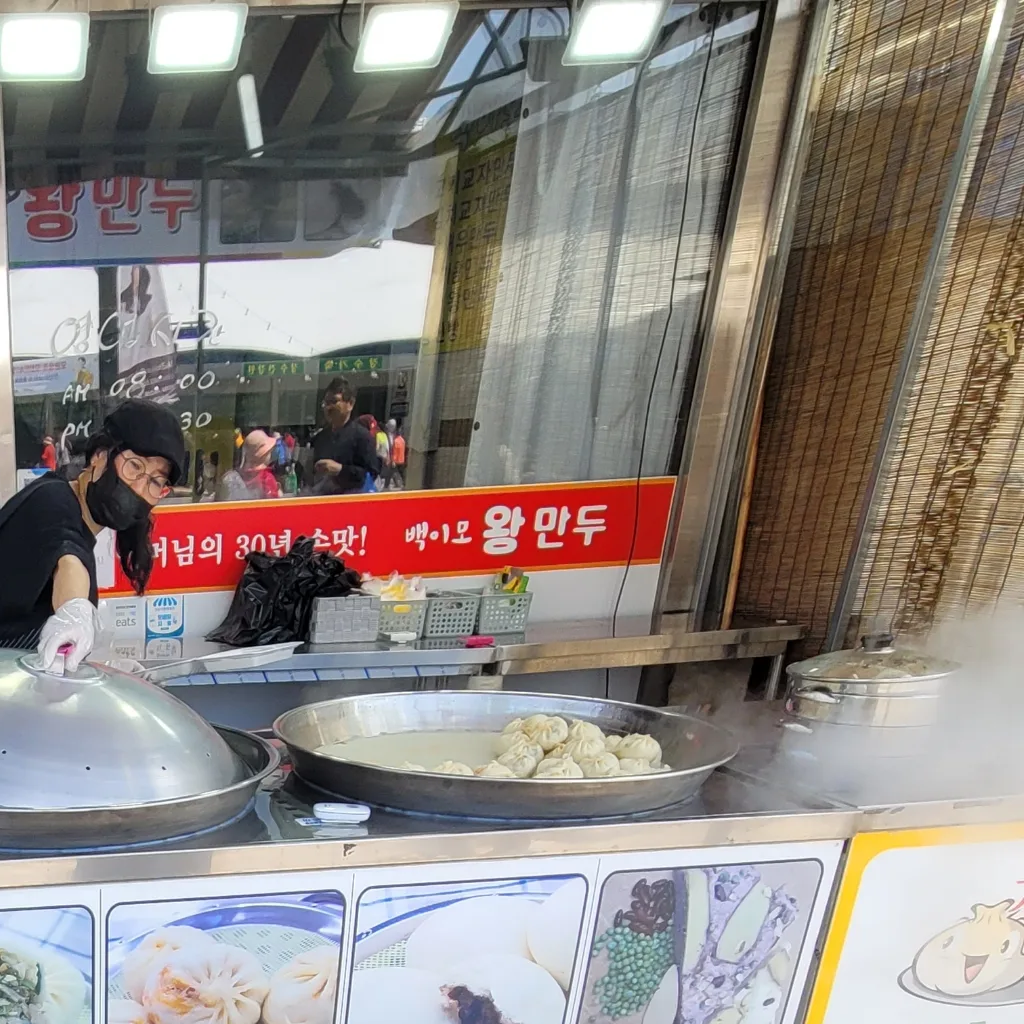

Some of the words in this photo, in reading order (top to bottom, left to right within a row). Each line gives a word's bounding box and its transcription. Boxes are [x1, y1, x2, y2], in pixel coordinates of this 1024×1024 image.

[23, 176, 198, 240] 왕만두
[62, 384, 91, 405] AM
[61, 419, 93, 451] PM
[117, 533, 223, 568] 머님의
[405, 520, 473, 551] 백이모
[115, 617, 137, 628] eats
